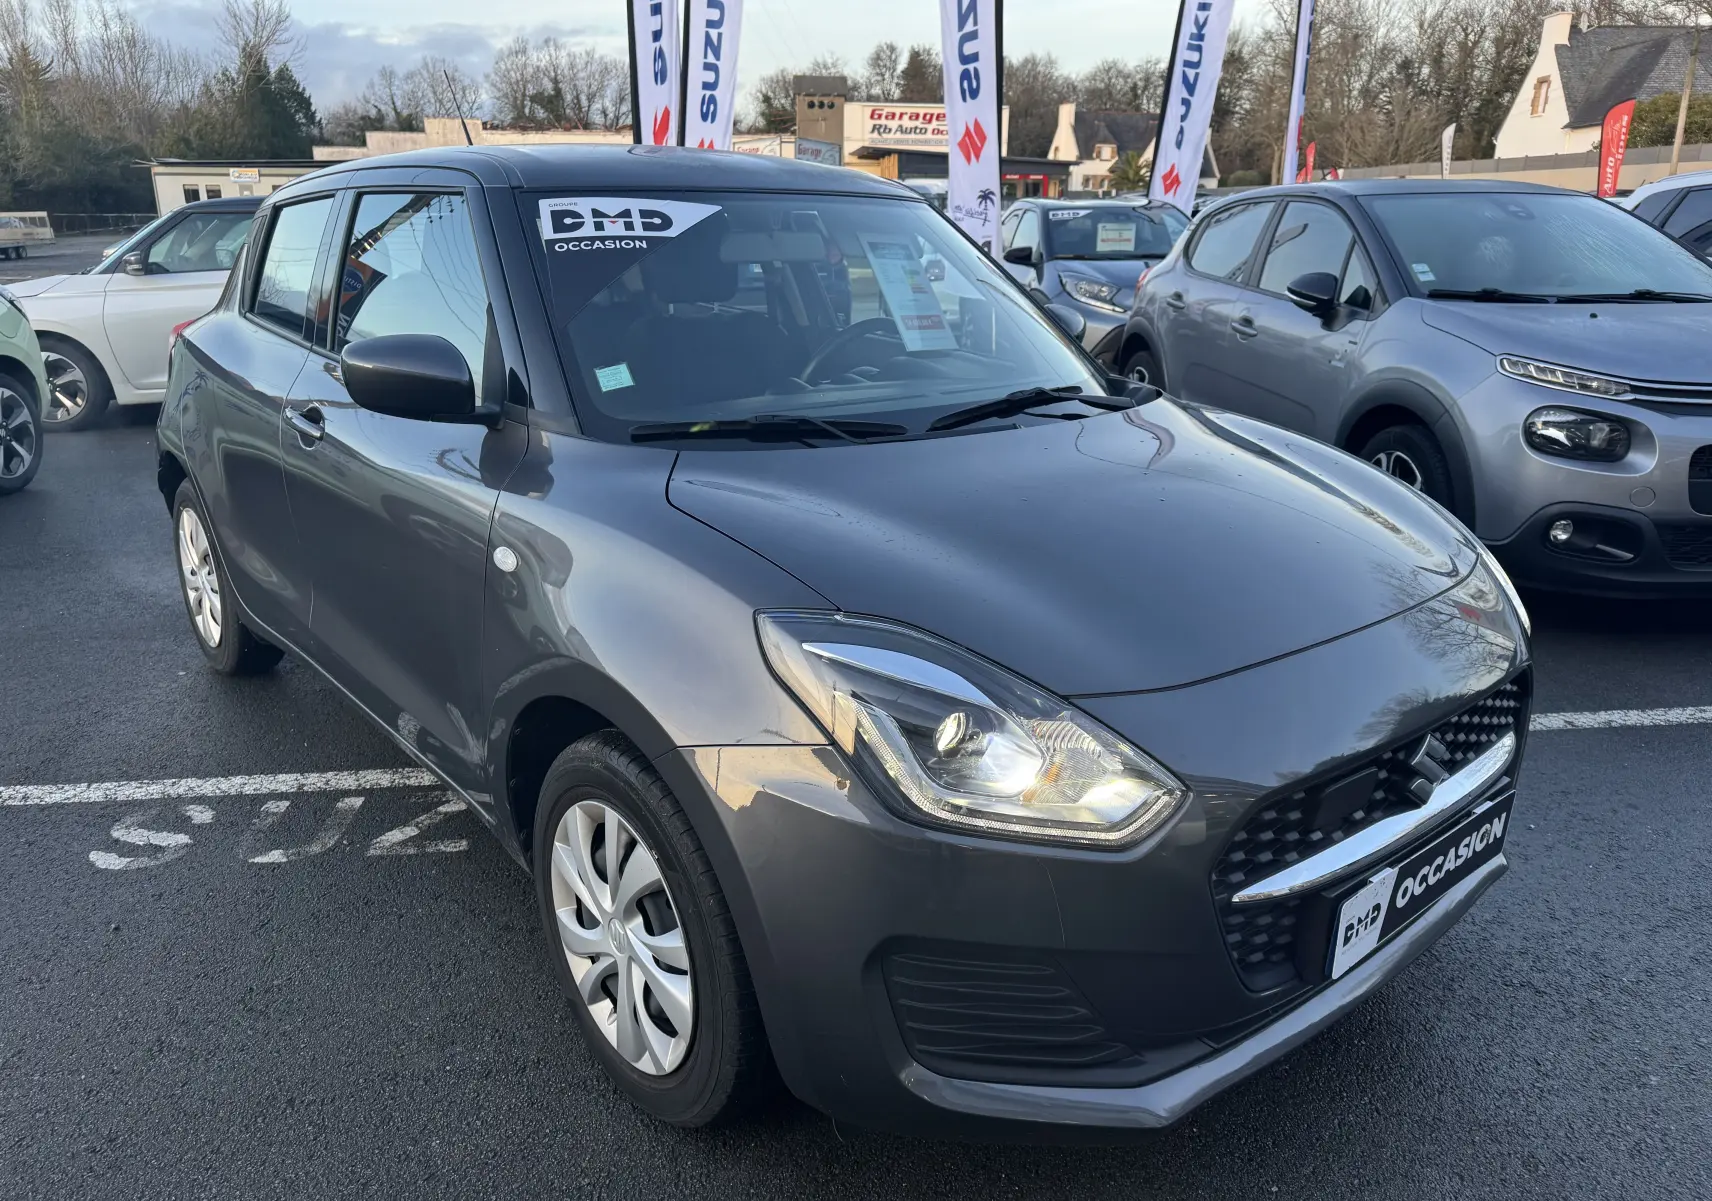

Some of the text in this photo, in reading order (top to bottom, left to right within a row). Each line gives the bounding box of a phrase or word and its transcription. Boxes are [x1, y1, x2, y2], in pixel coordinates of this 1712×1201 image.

[650, 0, 668, 86] SU
[869, 108, 947, 125] Garage
[894, 124, 928, 136] Auto
[550, 208, 674, 234] DMD
[554, 239, 648, 252] OCCASION
[1395, 811, 1507, 909] OCCASION
